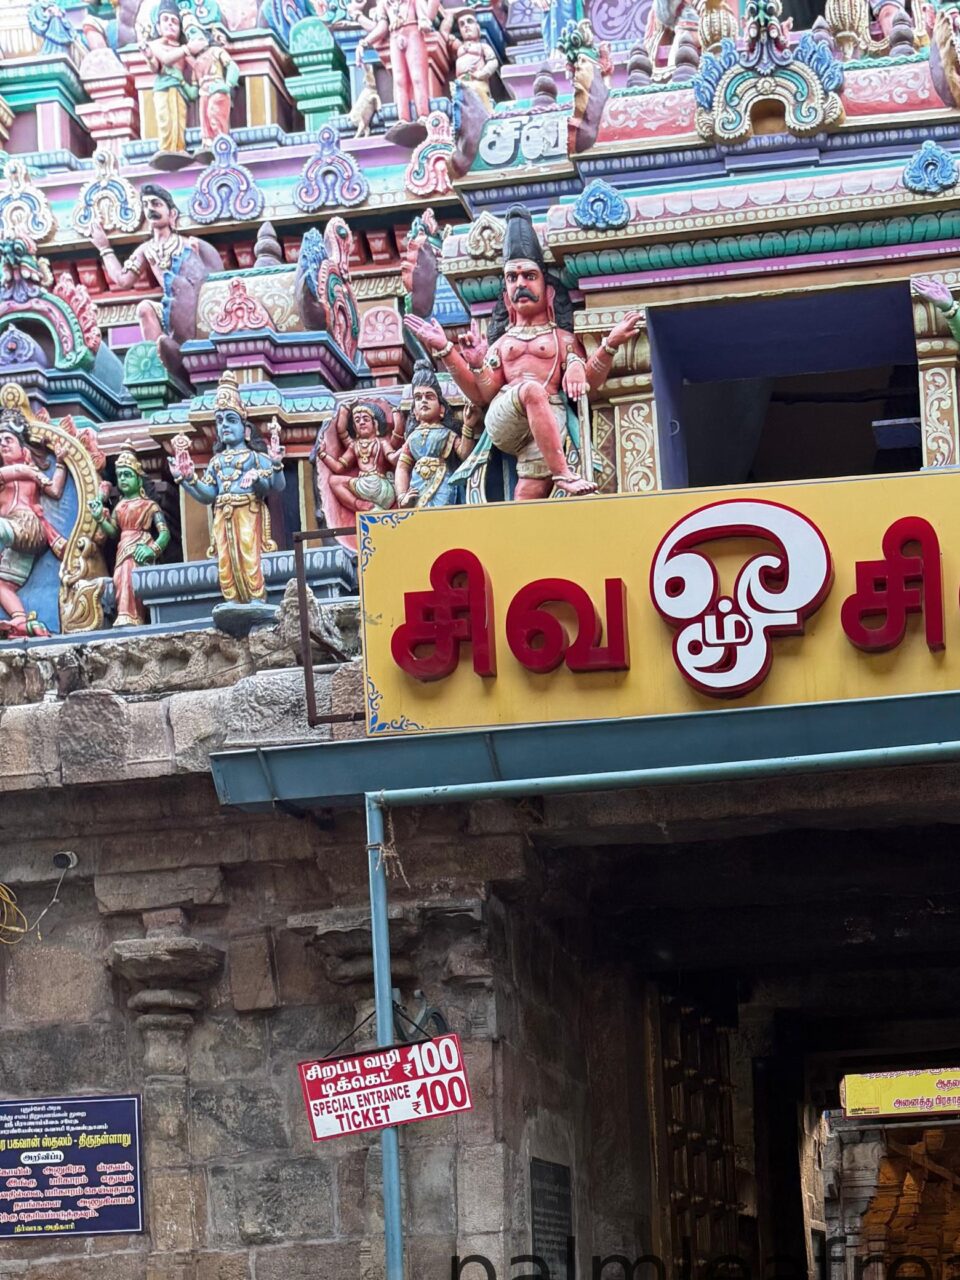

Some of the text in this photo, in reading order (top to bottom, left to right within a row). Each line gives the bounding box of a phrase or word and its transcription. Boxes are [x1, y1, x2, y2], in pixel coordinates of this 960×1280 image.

[391, 548, 631, 683] சிவ
[649, 498, 836, 698] ஓம்
[305, 1049, 401, 1082] சிறப்பு வழி
[321, 1069, 393, 1097] டிக்கெட்
[312, 1084, 411, 1117] SPECIAL ENTRANCE
[893, 1096, 934, 1109] அனைத்து
[335, 1104, 391, 1132] TICKET
[7, 1134, 41, 1149] பகவான்
[41, 1133, 73, 1150] ஸ்தலம்
[78, 1131, 131, 1149] திருநள்ளாறு
[22, 1152, 62, 1163] அறிவிப்பு
